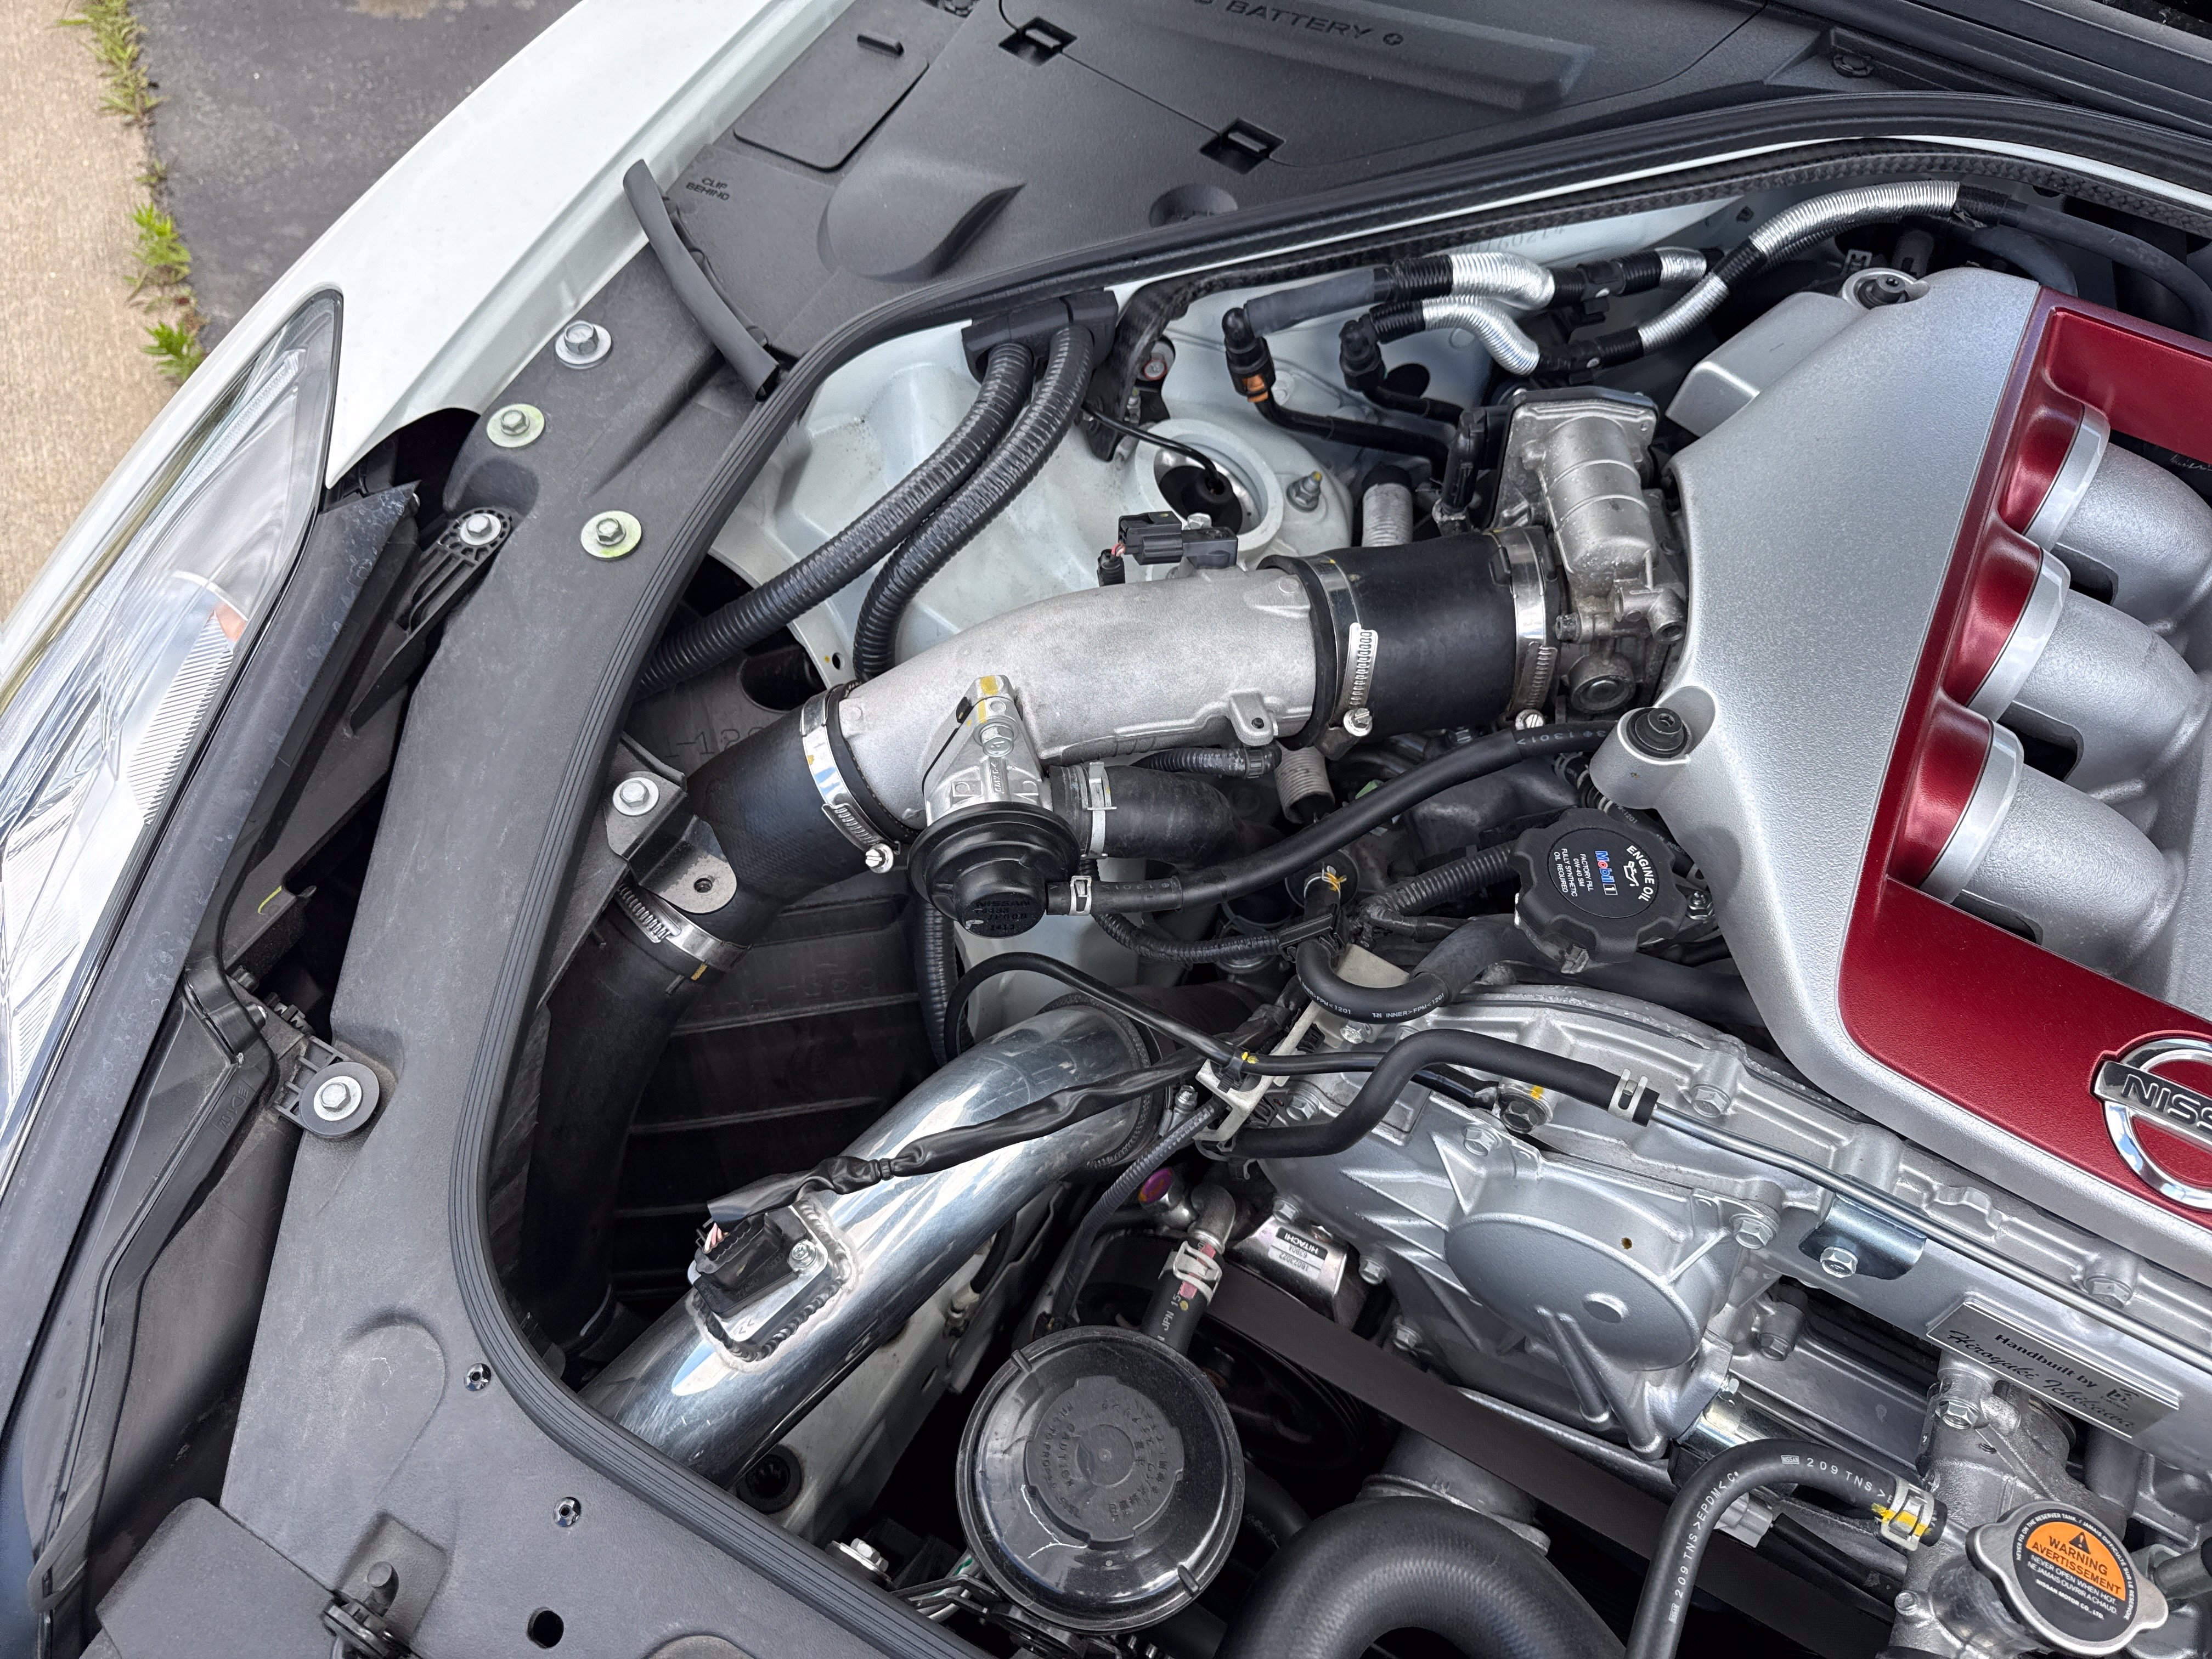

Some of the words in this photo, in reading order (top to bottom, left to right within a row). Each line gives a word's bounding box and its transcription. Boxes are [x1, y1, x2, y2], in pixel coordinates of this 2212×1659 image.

[1225, 0, 1373, 39] BATTERY
[686, 182, 730, 201] BEHIND
[1561, 848, 1571, 865] FULLY
[1579, 854, 1590, 880] FACTORY
[1595, 850, 1615, 883] Mobil
[1627, 845, 1655, 884] ENGINE
[1556, 864, 1568, 893] REQUIRED
[1565, 865, 1578, 897] SYNTHETIC
[1573, 859, 1582, 877] 0W-40
[1578, 877, 1585, 887] SM
[1638, 887, 1654, 902] OIL
[1284, 1233, 1318, 1254] HITACHI
[1162, 1310, 1174, 1331] JPN
[1947, 1330, 2040, 1380] Hiroyuki
[1995, 1334, 2075, 1377] Handbuilt
[2077, 1375, 2098, 1389] by
[1846, 1470, 1872, 1492] TNS
[1683, 1532, 1698, 1560] TNS
[2027, 1519, 2036, 1528] THE
[2123, 1566, 2132, 1581] SUR
[2128, 1581, 2134, 1590] LE
[2049, 1536, 2108, 1576] WARNING
[2028, 1561, 2038, 1571] NE
[2037, 1567, 2061, 1584] JAMAIS
[2031, 1554, 2054, 1571] NEVER
[2056, 1567, 2076, 1583] OPEN
[2077, 1578, 2099, 1596] WHEN
[2032, 1542, 2121, 1594] AVERTISSEMENT
[2036, 1579, 2057, 1595] NISSAN
[2058, 1590, 2079, 1606] MOTOR
